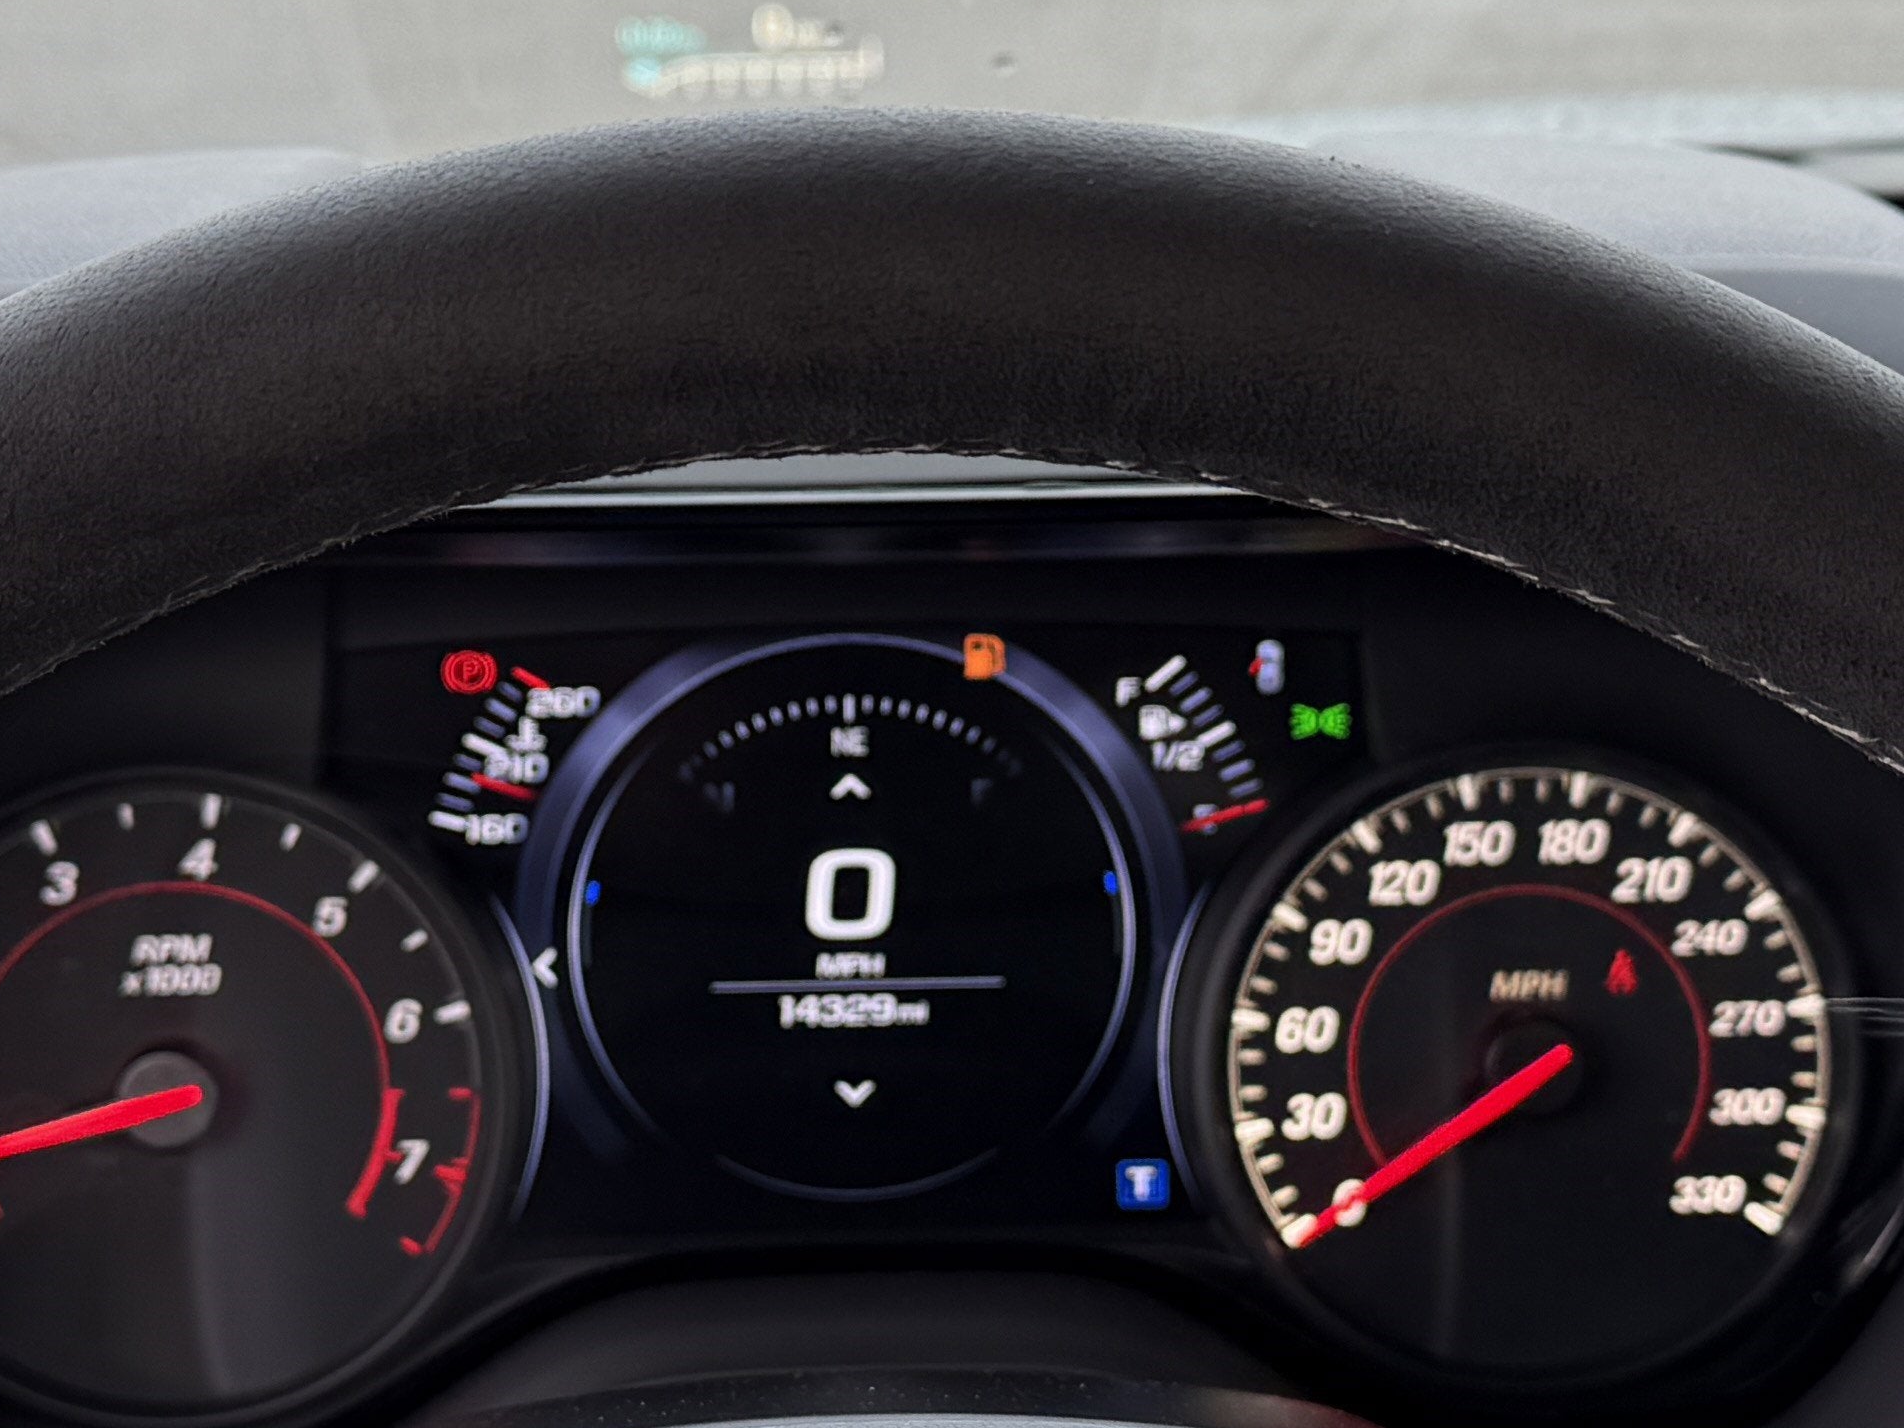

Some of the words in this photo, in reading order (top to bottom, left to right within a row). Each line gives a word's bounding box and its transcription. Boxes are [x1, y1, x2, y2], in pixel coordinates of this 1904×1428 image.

[180, 837, 218, 880] 4
[1443, 821, 1516, 866] 150
[1538, 819, 1611, 865] 180
[42, 861, 80, 907] 3
[805, 847, 896, 941] 0
[1369, 860, 1440, 906] 120
[1611, 856, 1693, 903] 210
[314, 897, 349, 937] 5
[1671, 919, 1748, 957] 240
[129, 934, 212, 965] RPM
[1309, 919, 1372, 965] 90
[815, 952, 886, 980] MPH
[1489, 970, 1569, 1002] MPH
[384, 998, 422, 1042] 6
[1275, 1006, 1339, 1053] 60
[1709, 999, 1785, 1037] 270
[1282, 1093, 1346, 1140] 30
[1709, 1087, 1786, 1126] 300
[397, 1138, 429, 1183] 7
[1669, 1175, 1746, 1214] 330
